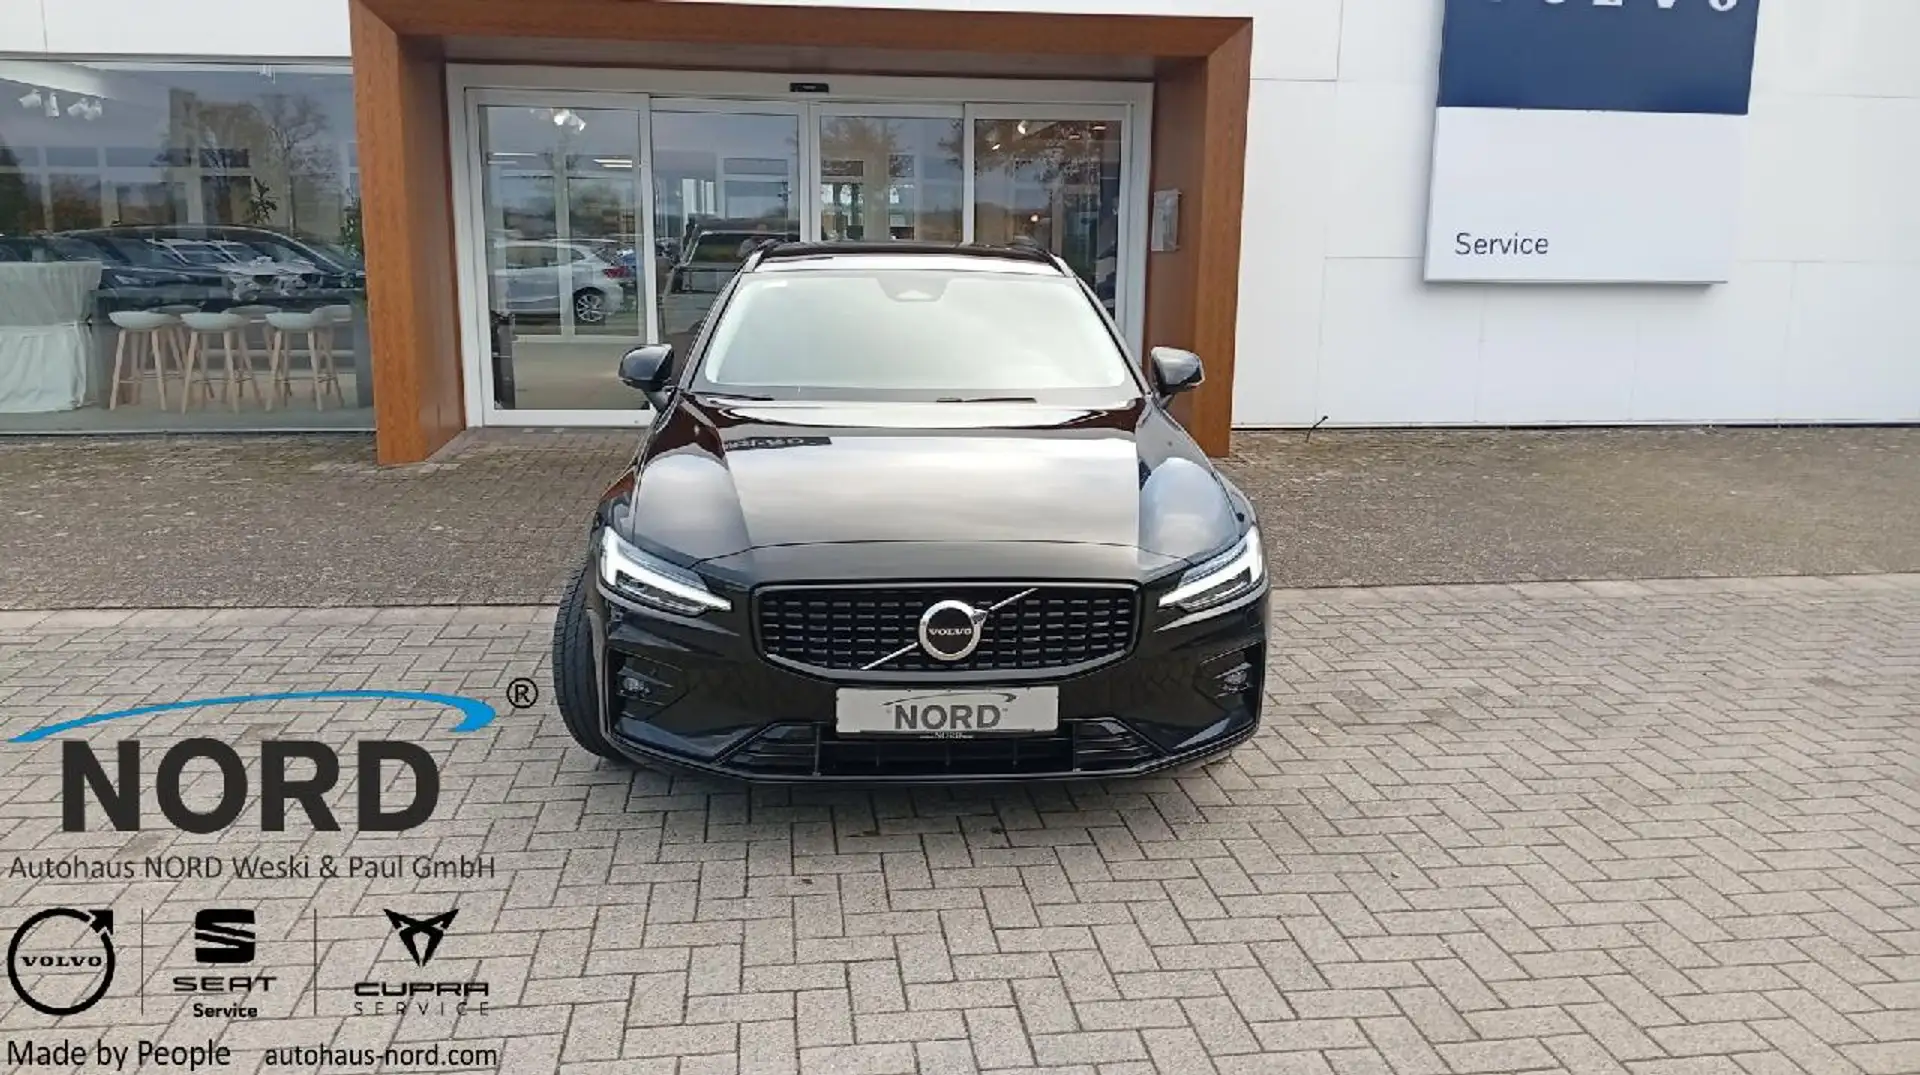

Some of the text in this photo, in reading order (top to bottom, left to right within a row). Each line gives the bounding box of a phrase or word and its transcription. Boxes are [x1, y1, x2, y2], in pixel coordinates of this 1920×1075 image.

[1454, 231, 1549, 256] Service
[928, 628, 972, 636] VOLVO
[894, 704, 1001, 730] NORD
